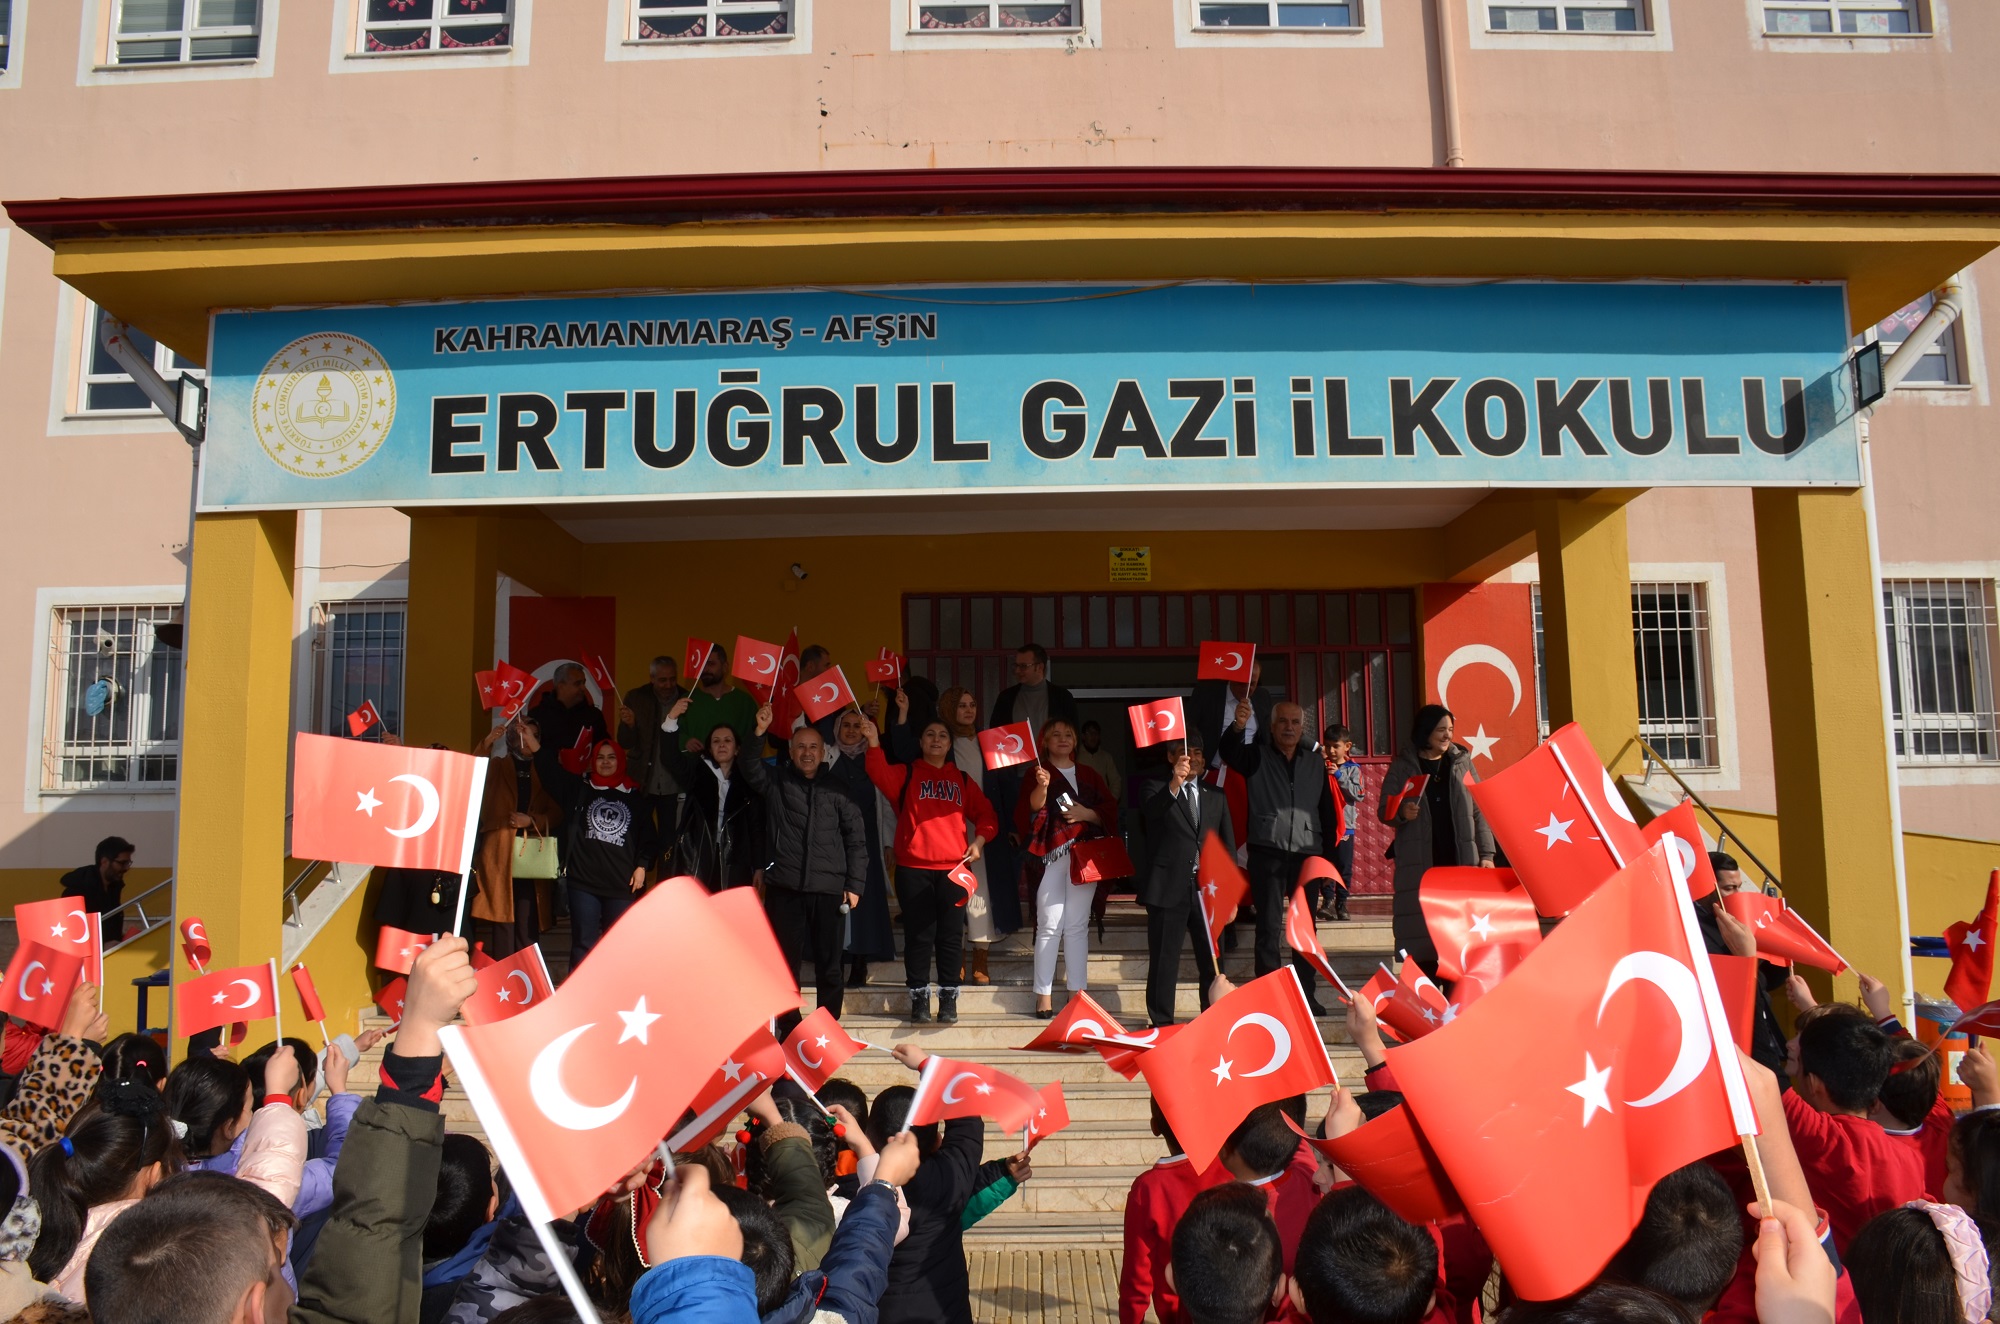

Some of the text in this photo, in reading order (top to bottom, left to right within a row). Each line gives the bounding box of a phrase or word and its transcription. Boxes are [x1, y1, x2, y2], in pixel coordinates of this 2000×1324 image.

[434, 318, 792, 353] KAHRAMANMARAŞ
[279, 360, 320, 416] CUMHURİYETİ
[349, 368, 369, 400] EĞİTİM
[281, 419, 312, 449] TÜRKİYE
[332, 403, 369, 448] BAKANLIĞI
[430, 370, 990, 475] ERTUĞRUL
